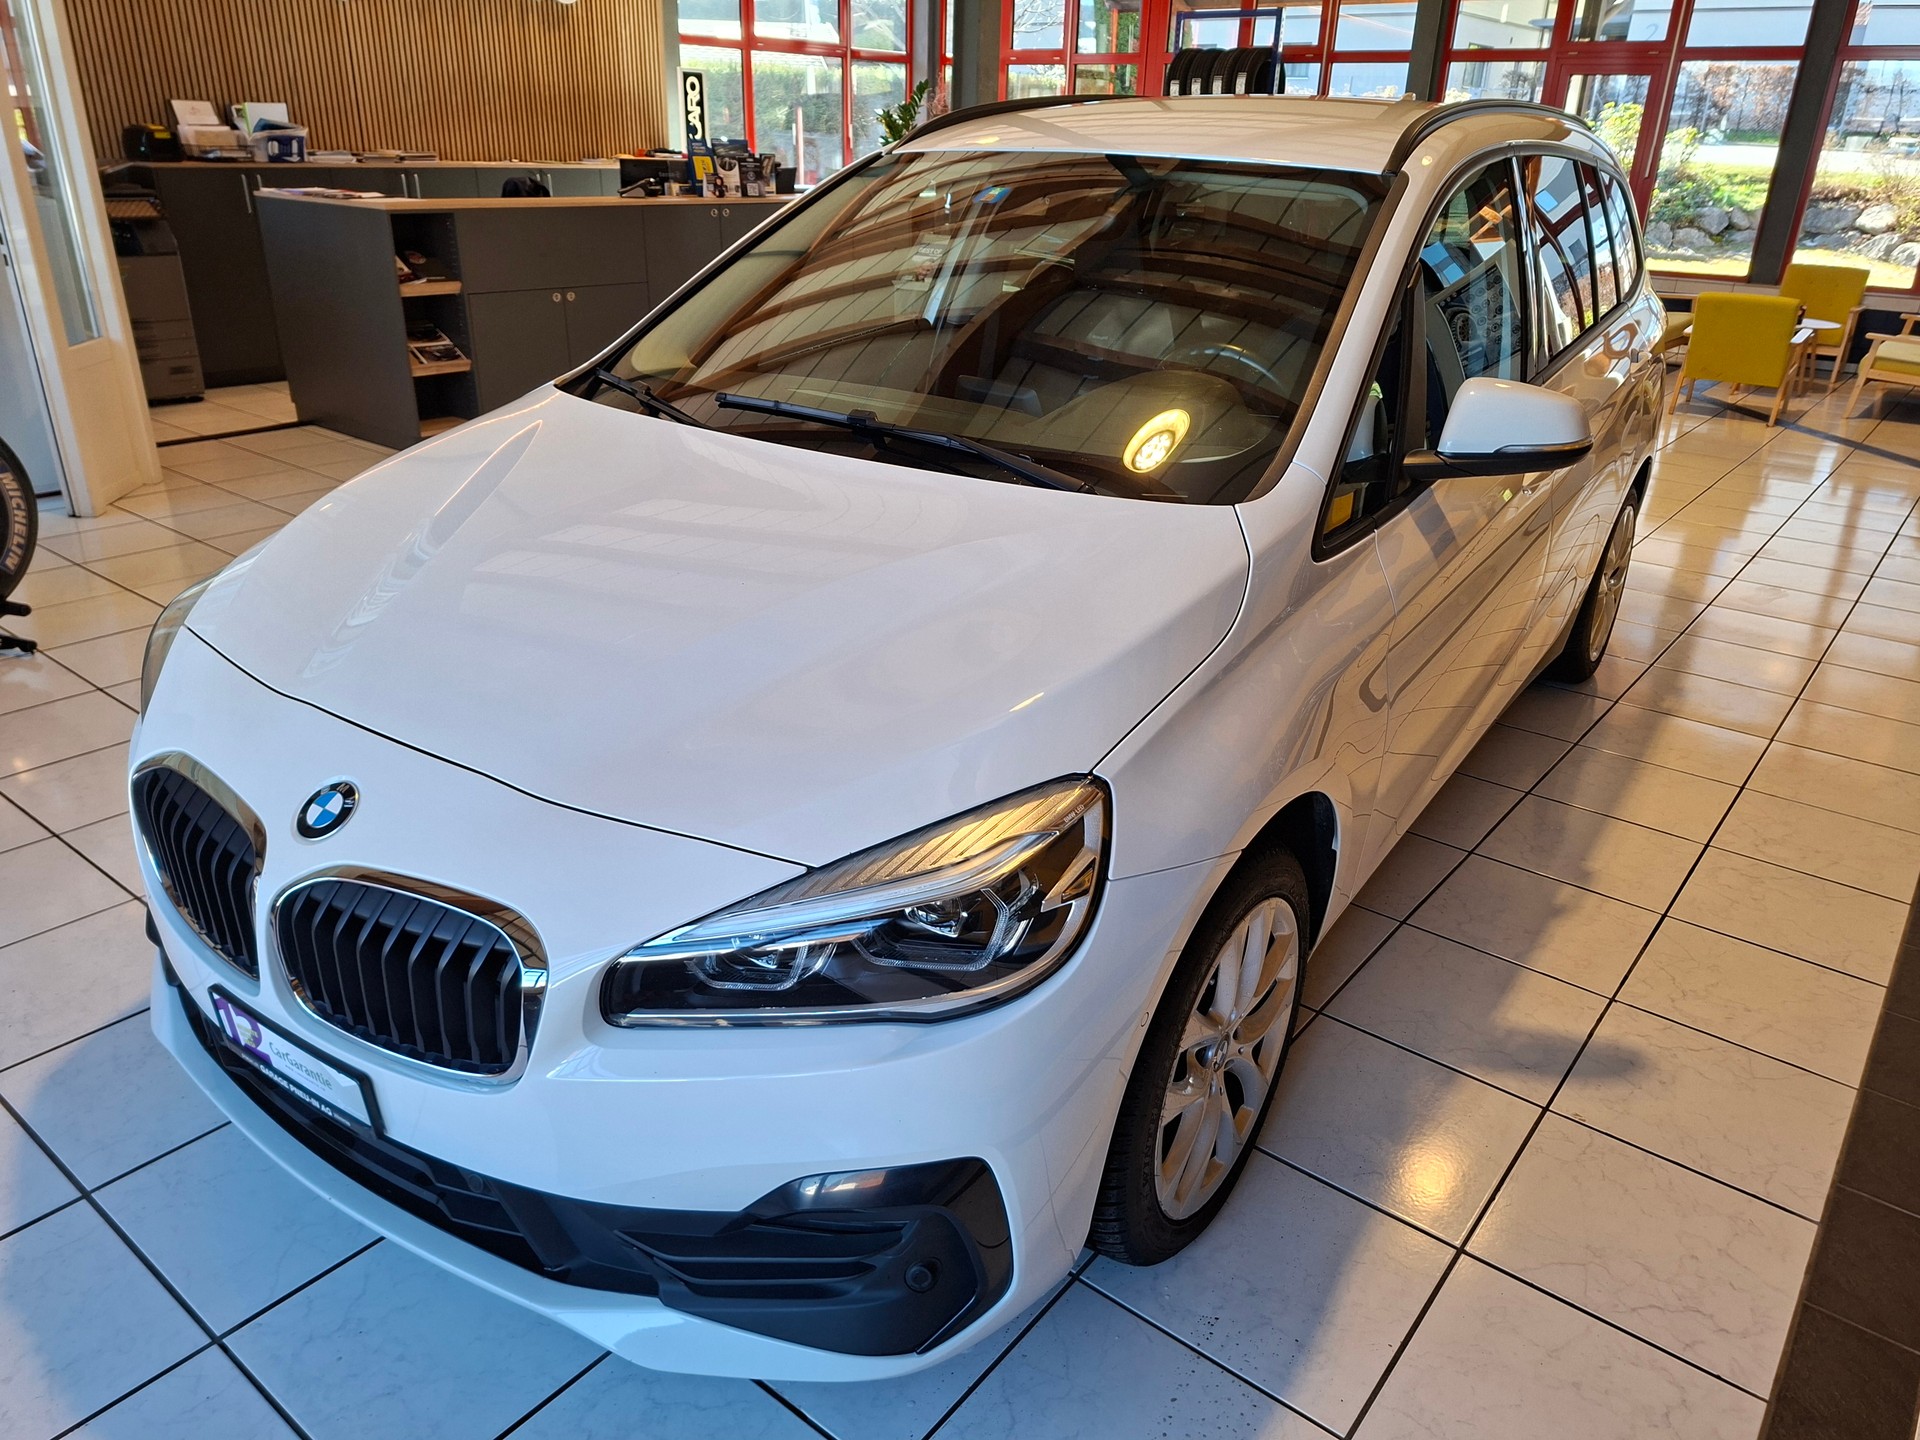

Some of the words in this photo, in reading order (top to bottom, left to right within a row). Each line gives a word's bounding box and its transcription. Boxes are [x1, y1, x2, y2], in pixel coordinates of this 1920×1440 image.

[1, 471, 28, 570] MICHELIN
[1074, 804, 1085, 814] LED
[259, 1064, 290, 1090] GARAGE
[268, 1041, 333, 1090] CarGarantie
